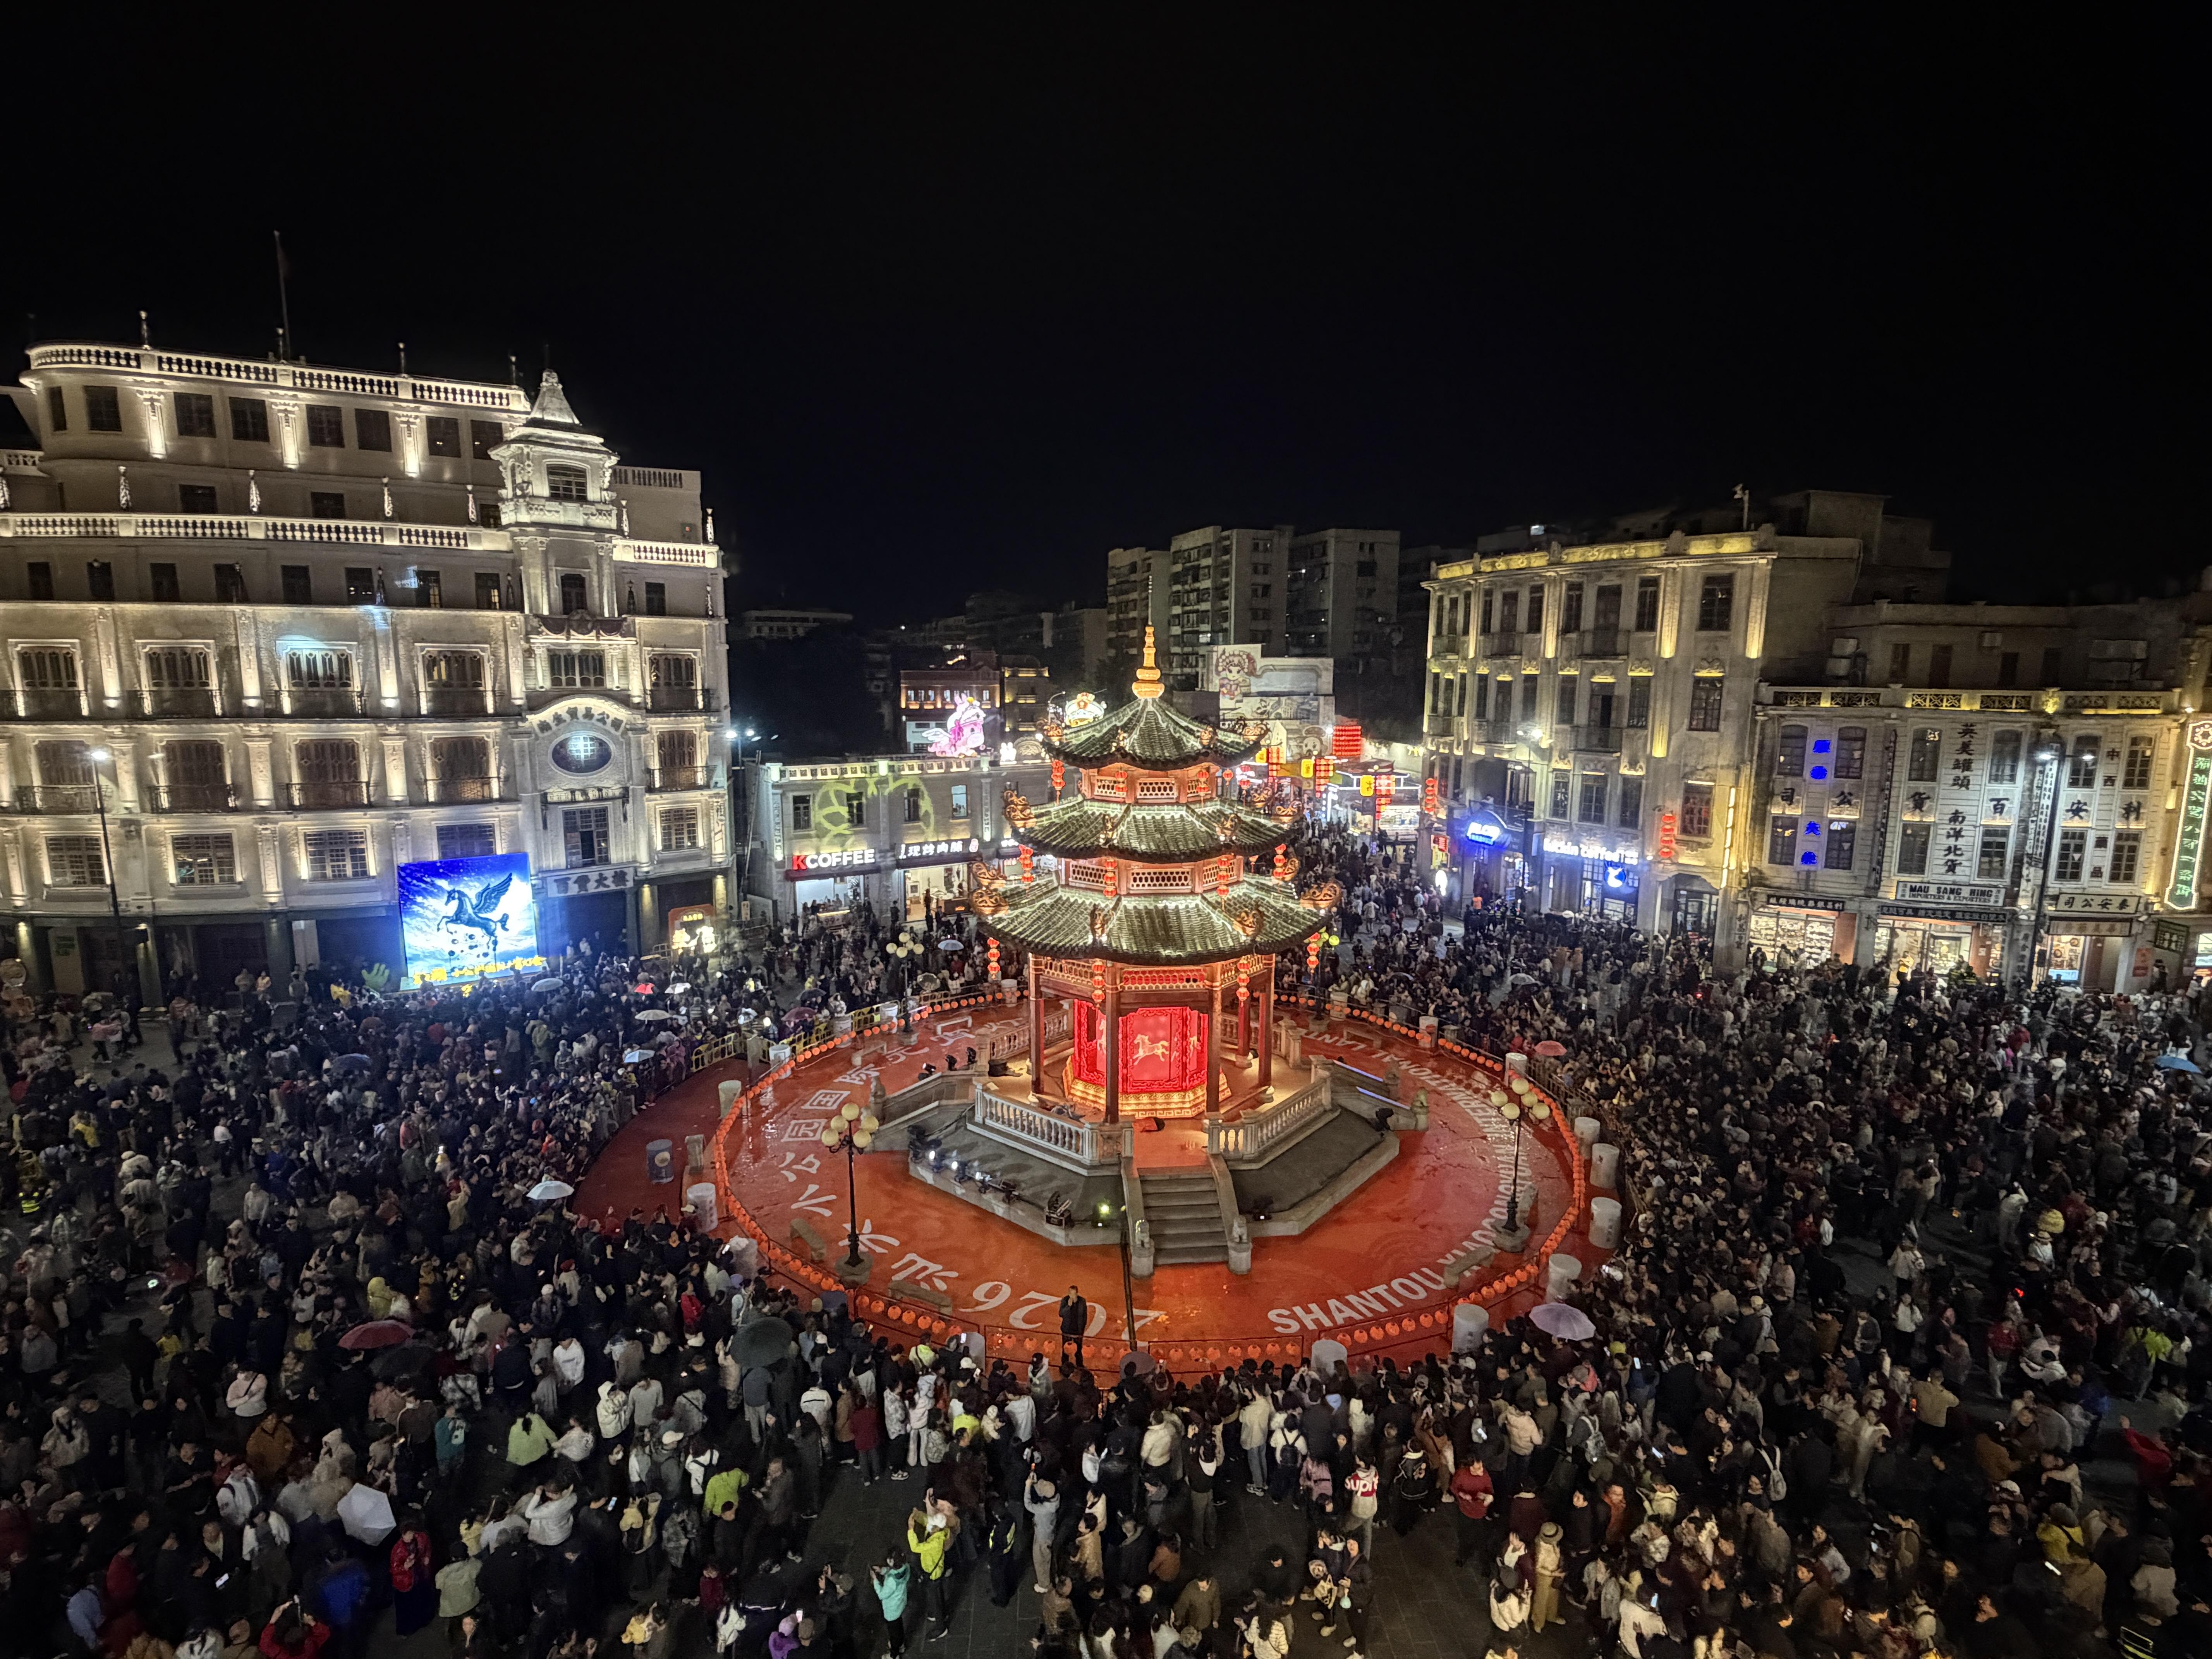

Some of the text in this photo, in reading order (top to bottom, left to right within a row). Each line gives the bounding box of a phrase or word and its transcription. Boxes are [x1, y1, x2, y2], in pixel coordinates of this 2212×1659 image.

[1909, 884, 1929, 893] MAU
[1936, 886, 1962, 895] SANG
[1969, 889, 1993, 897] HING
[1267, 1267, 1447, 1334] SHANTOU
